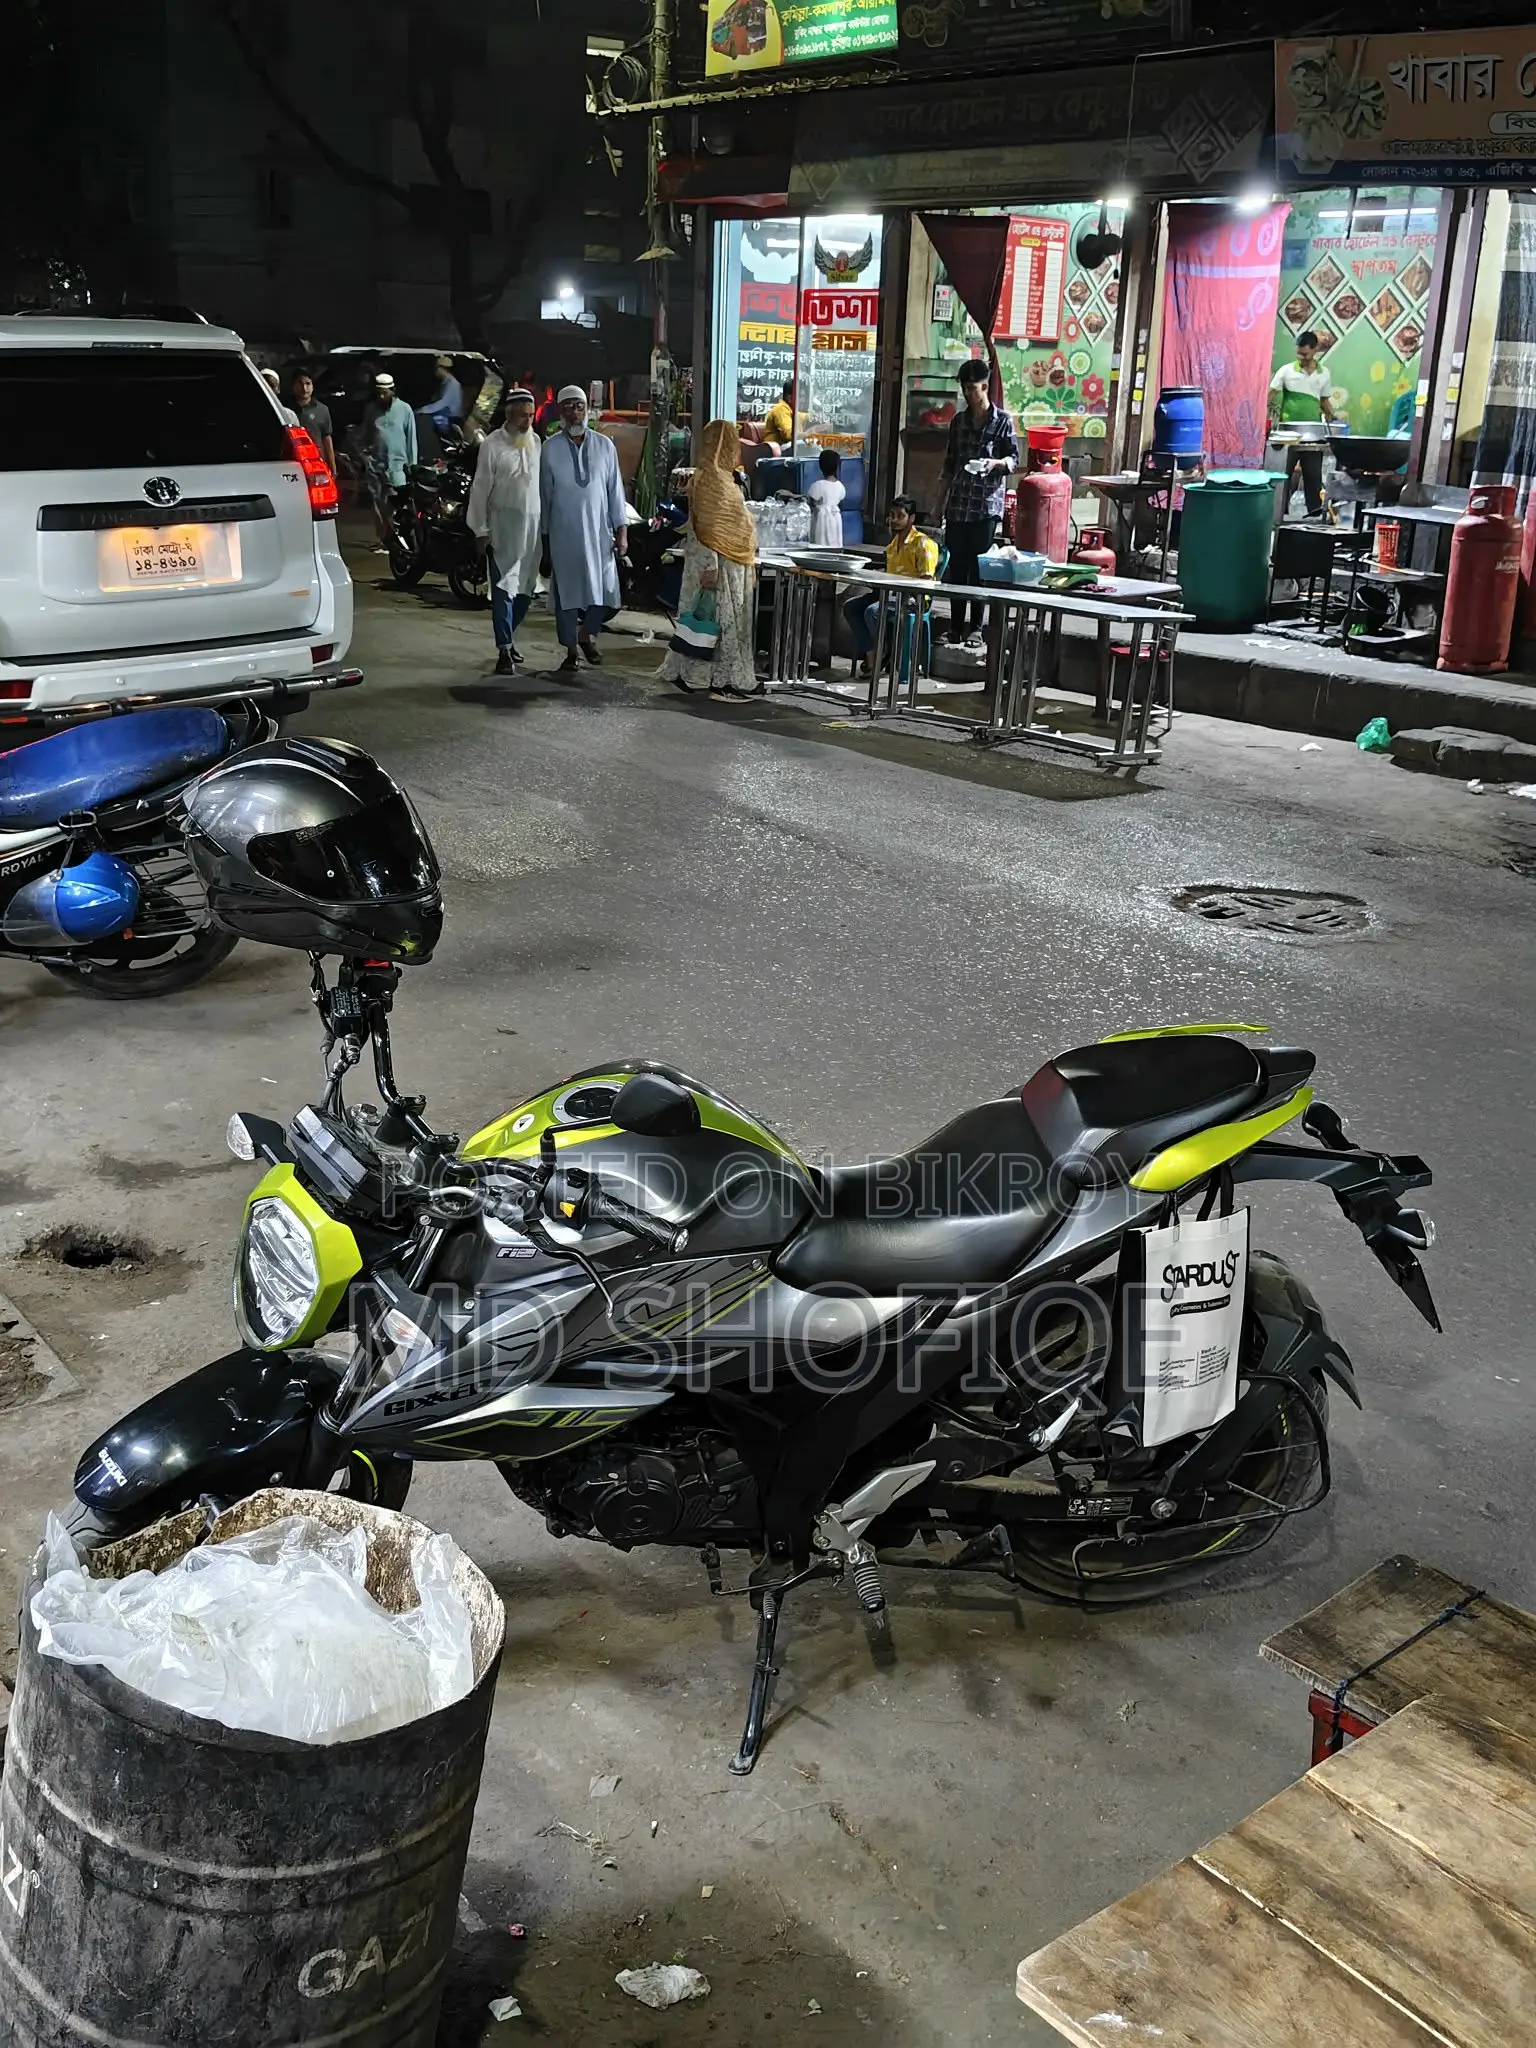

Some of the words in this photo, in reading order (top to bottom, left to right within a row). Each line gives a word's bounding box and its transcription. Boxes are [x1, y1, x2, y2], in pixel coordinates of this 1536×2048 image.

[1387, 50, 1504, 104] খাবার
[802, 289, 879, 326] তিশা
[132, 545, 155, 557] ঢাকা
[135, 556, 197, 572] ১৪-৪৬৯০
[1, 853, 44, 878] ROYAL
[383, 1378, 491, 1417] GIXXER
[98, 1446, 128, 1487] SUZUKI
[297, 1907, 434, 1999] GAZI
